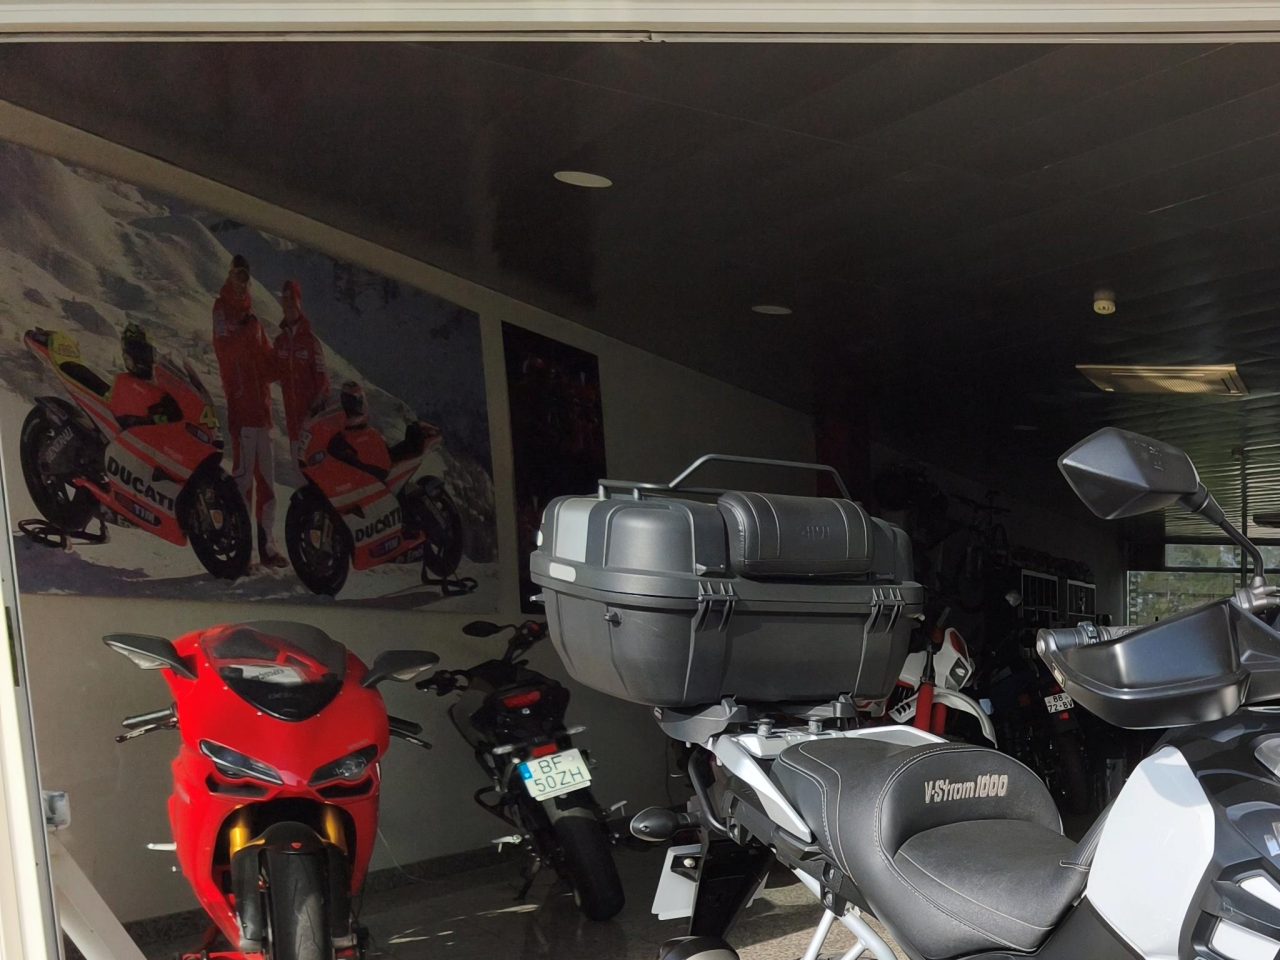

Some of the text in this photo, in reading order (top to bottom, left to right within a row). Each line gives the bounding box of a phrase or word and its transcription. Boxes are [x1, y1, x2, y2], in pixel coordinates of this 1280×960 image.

[106, 455, 175, 512] DUCATI
[354, 507, 402, 543] DUCATI
[537, 754, 563, 775] BF
